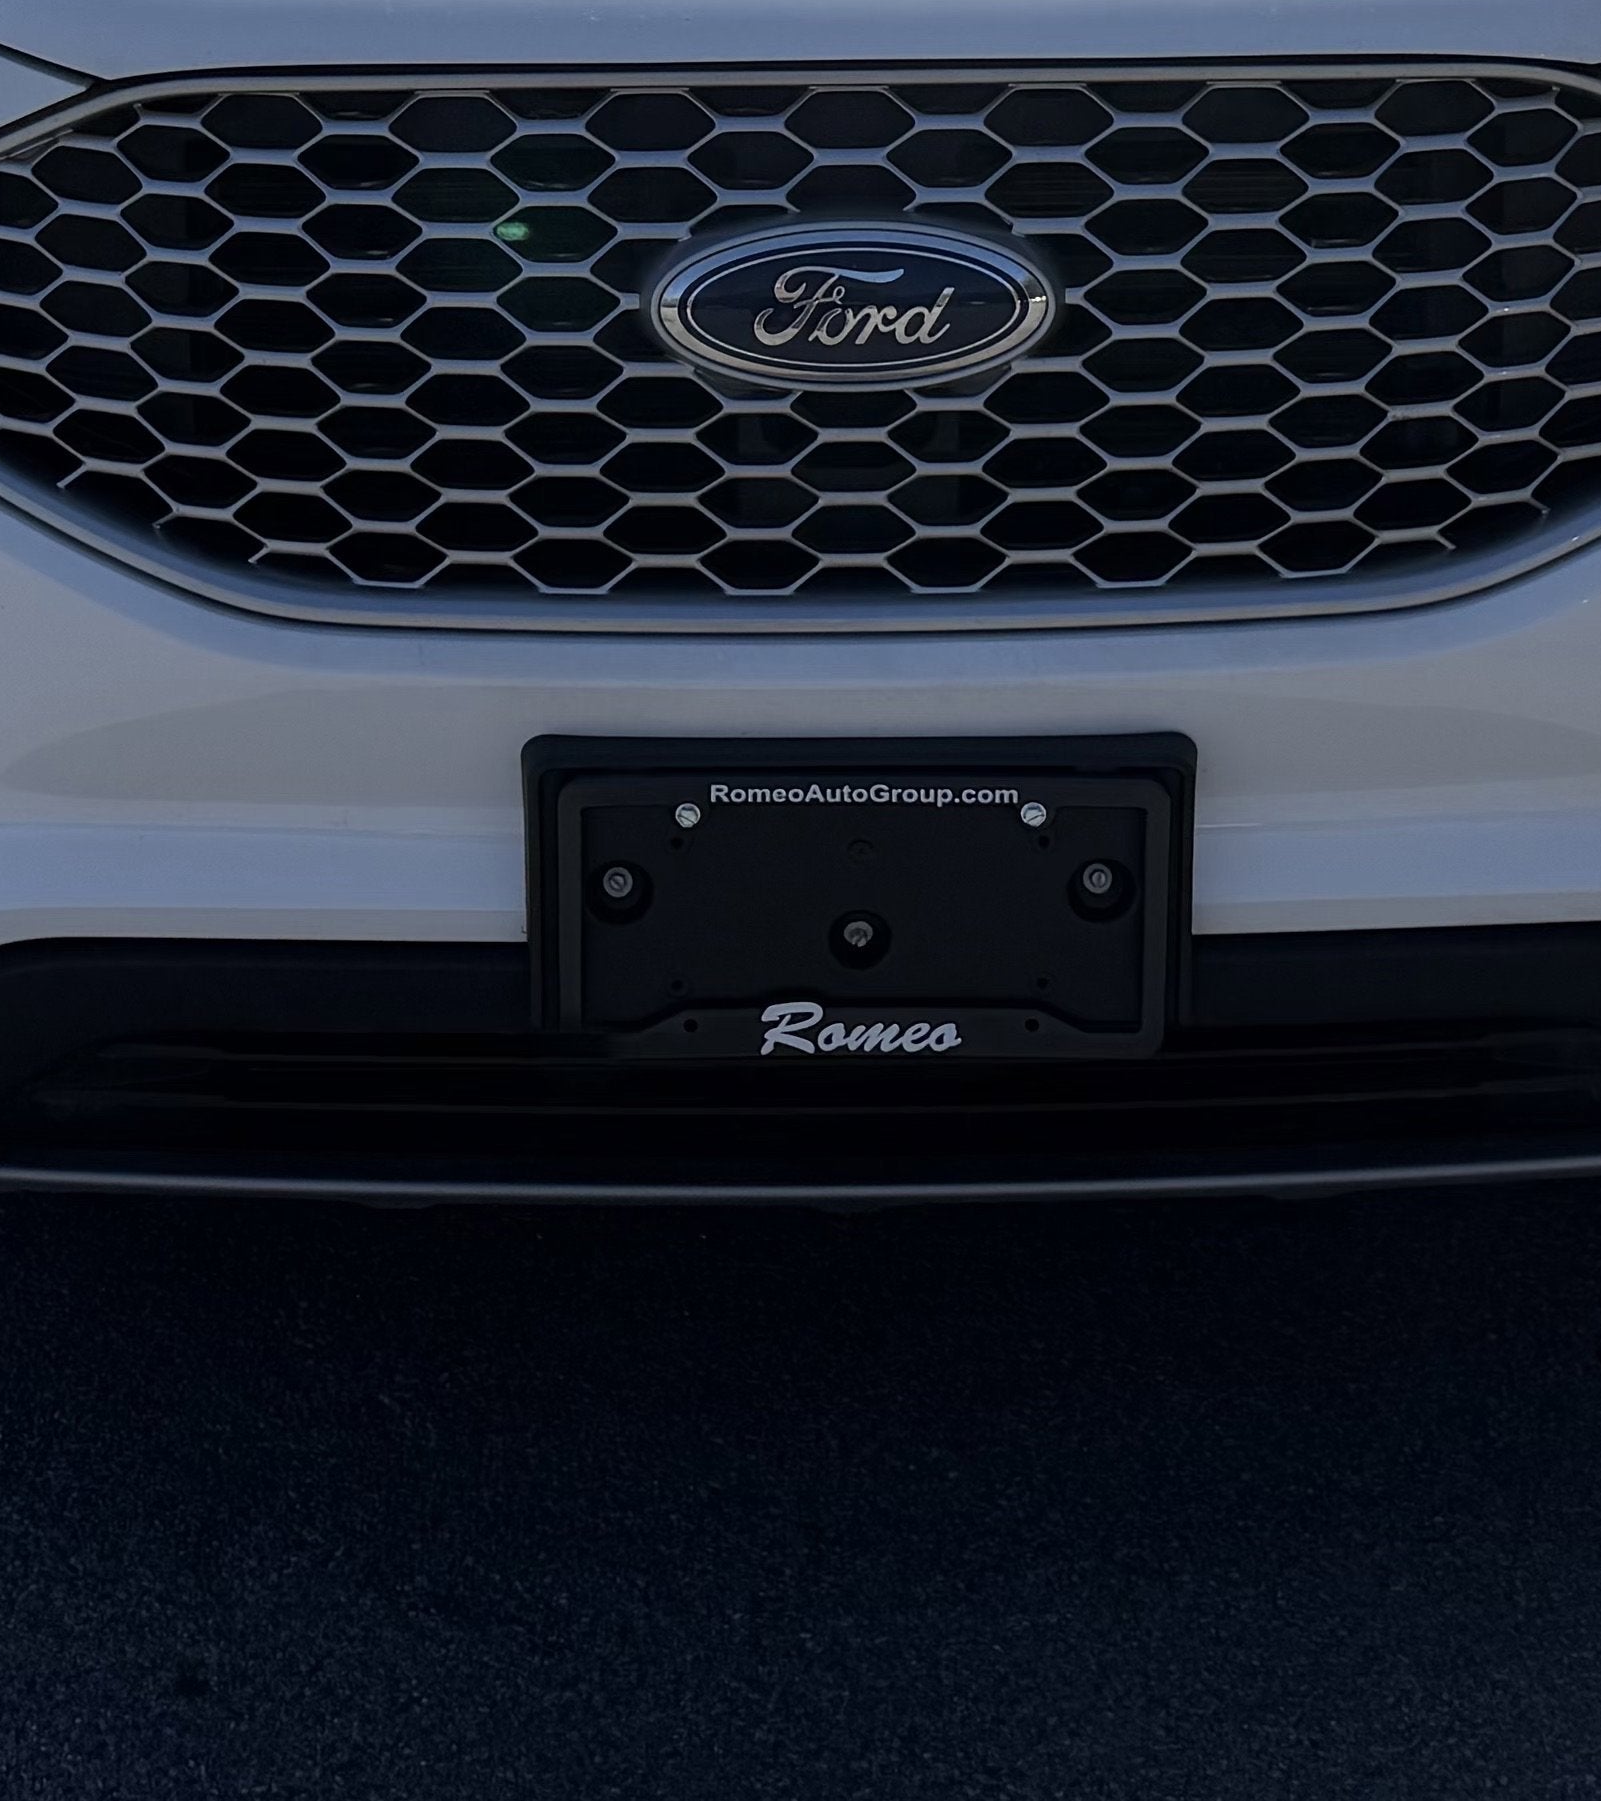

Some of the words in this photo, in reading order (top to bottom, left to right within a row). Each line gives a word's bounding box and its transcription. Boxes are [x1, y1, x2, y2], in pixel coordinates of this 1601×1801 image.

[753, 265, 956, 346] Ford
[710, 783, 1019, 808] RomeoAutoGroup.com
[760, 1001, 962, 1056] Romeo
